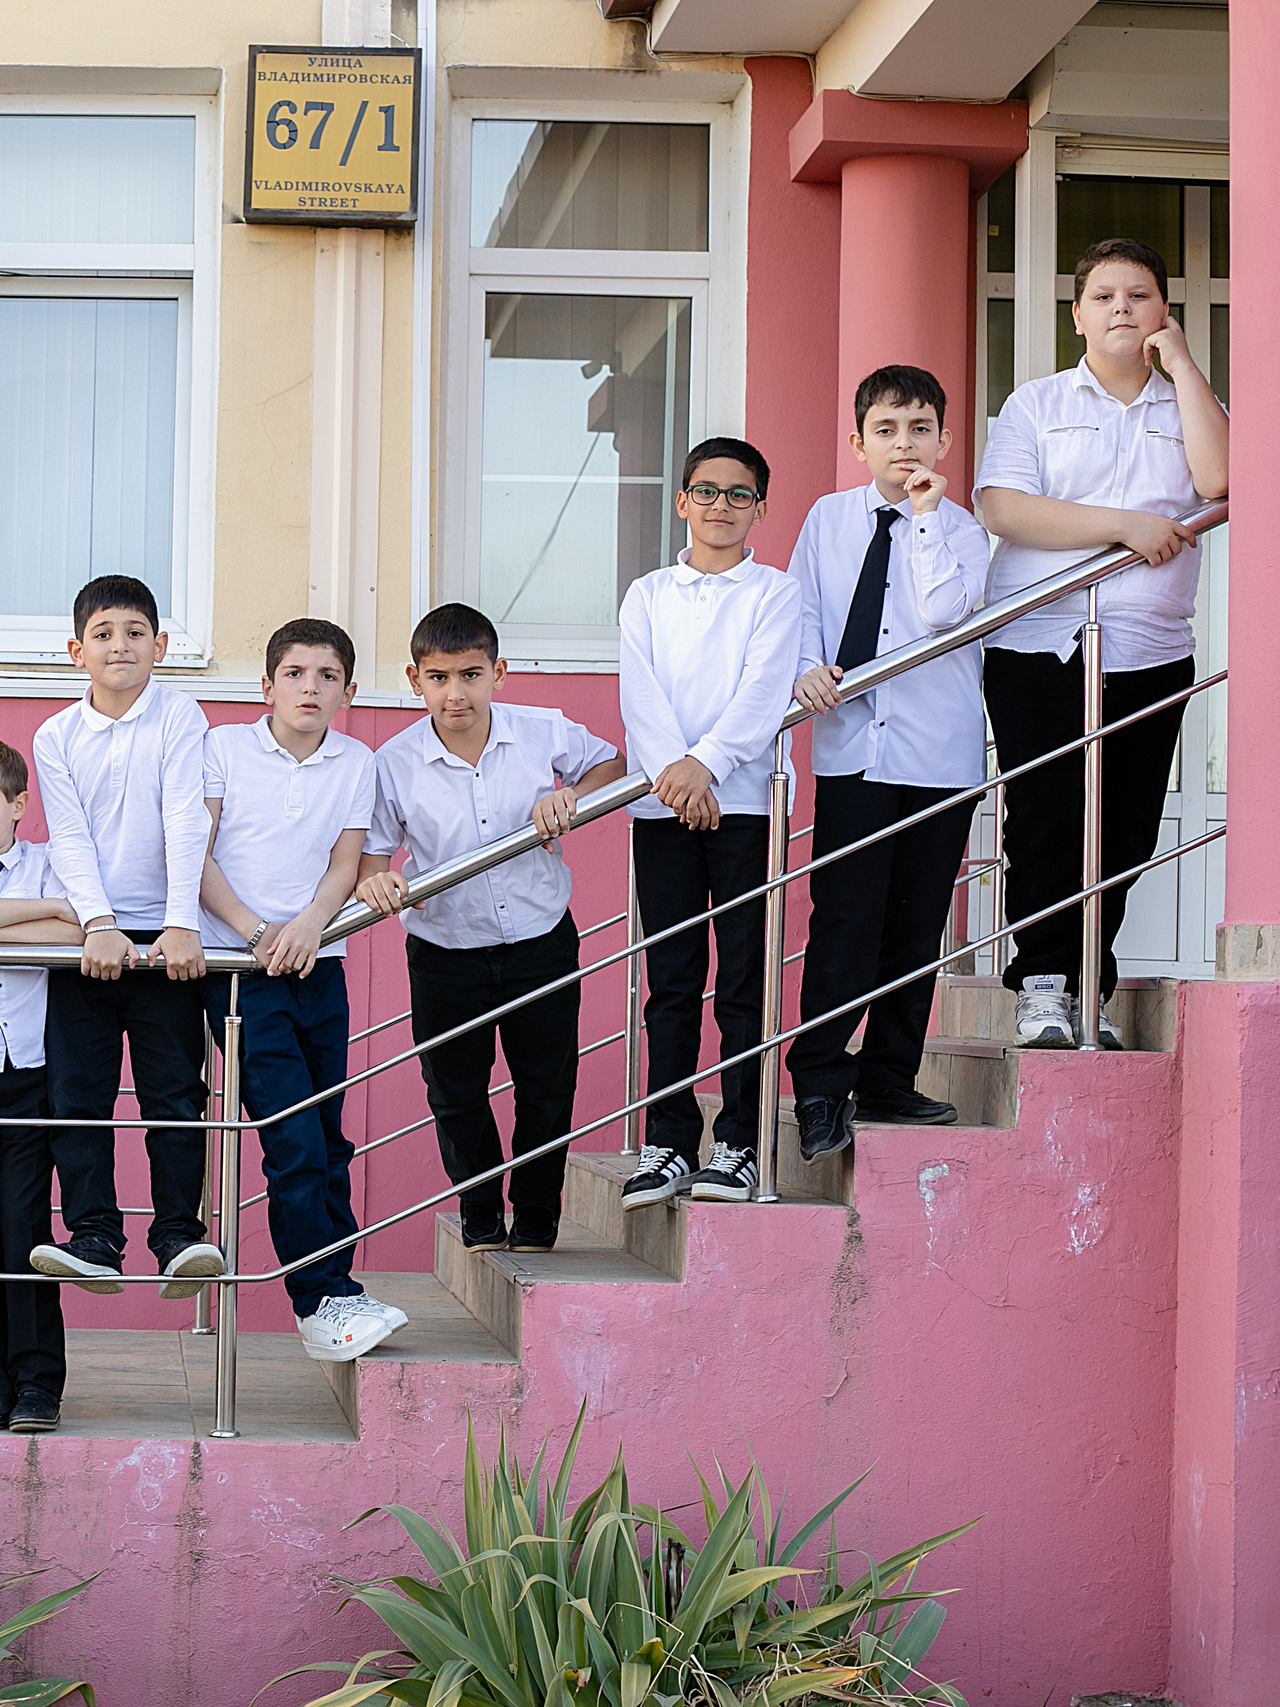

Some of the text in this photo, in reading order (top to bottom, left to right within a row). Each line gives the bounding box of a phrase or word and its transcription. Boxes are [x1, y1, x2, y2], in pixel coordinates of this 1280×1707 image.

[308, 57, 363, 70] УЛИЦА
[258, 72, 412, 84] ВЛАДИМИРОВСКАЯ
[266, 100, 400, 166] 67/1
[254, 180, 405, 194] VLADIMIROVSKAYA
[298, 197, 360, 208] STREET
